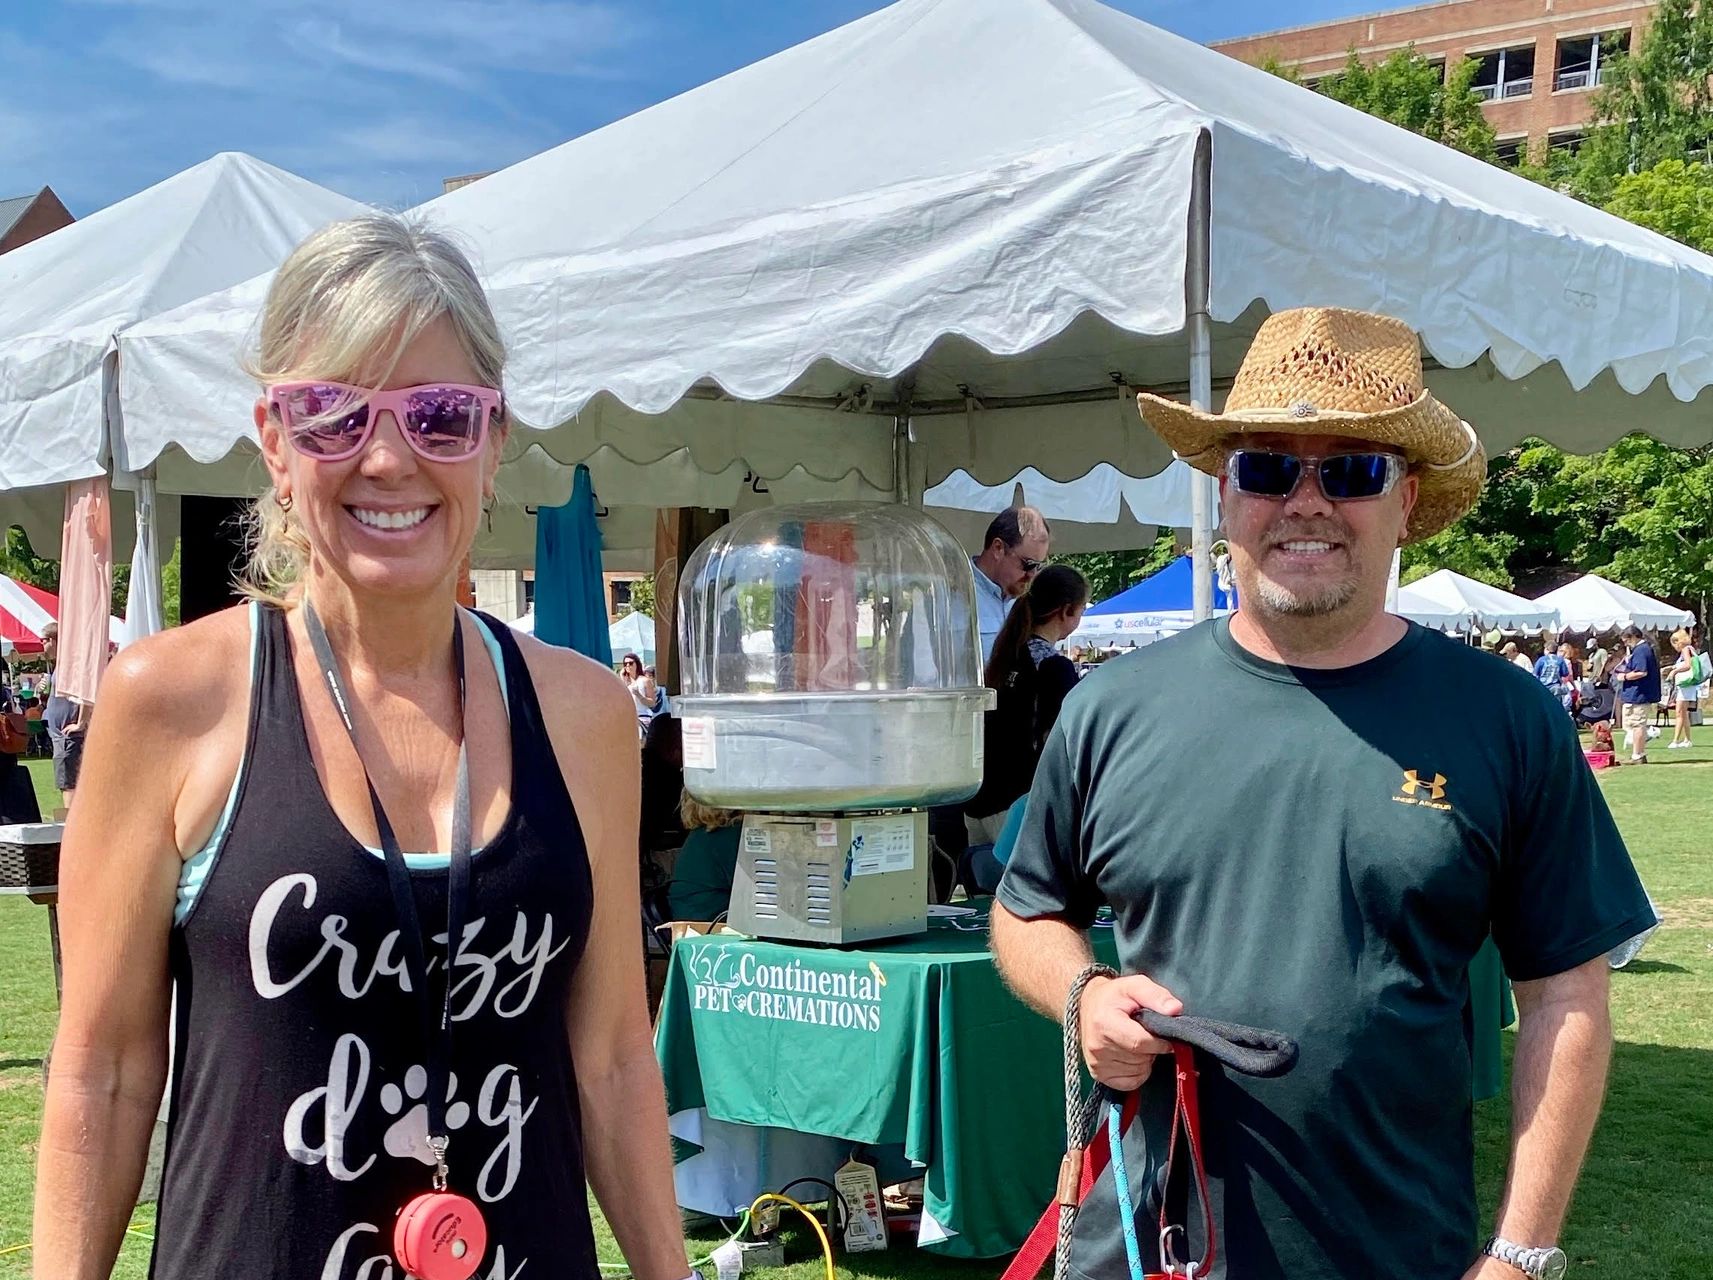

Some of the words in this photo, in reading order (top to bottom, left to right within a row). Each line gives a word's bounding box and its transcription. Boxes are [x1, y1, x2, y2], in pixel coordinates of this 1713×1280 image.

[740, 953, 883, 1001] Continental
[694, 985, 732, 1013] PET
[746, 990, 881, 1032] CREMATIONS
